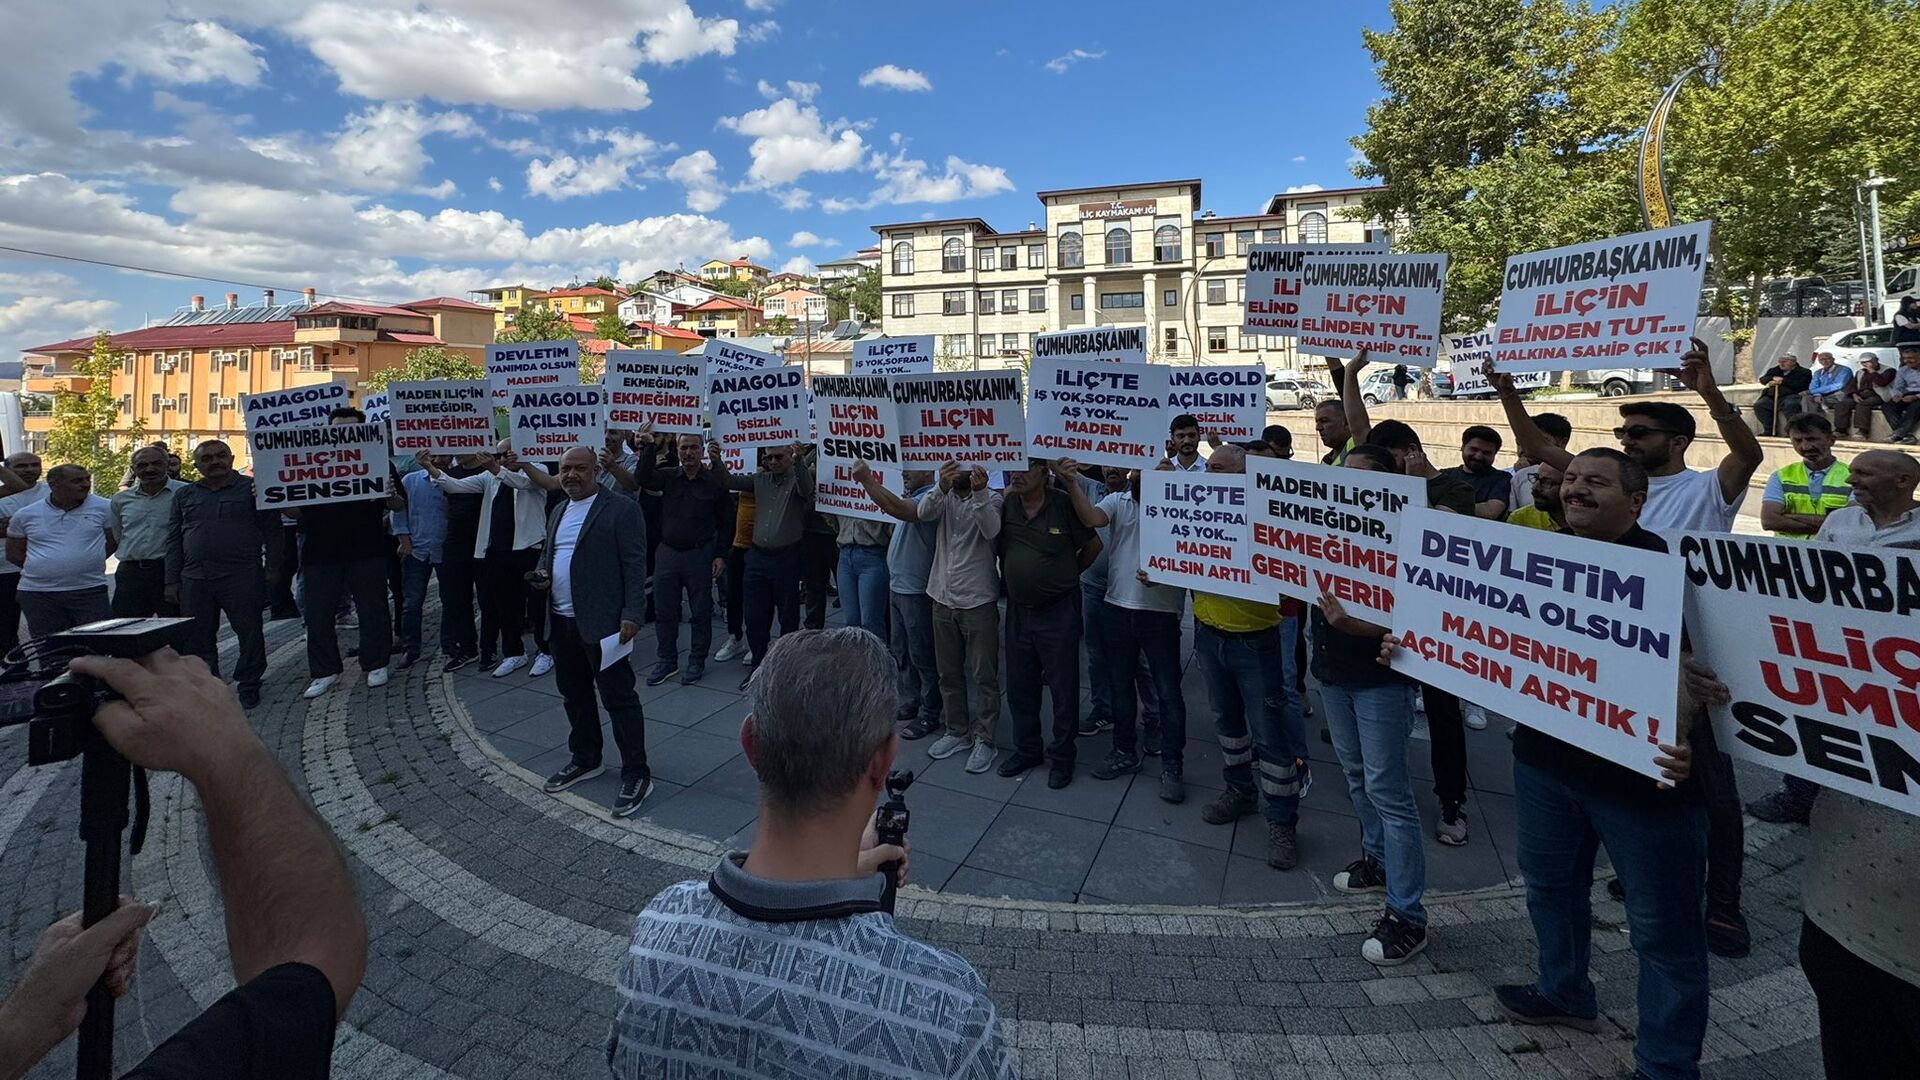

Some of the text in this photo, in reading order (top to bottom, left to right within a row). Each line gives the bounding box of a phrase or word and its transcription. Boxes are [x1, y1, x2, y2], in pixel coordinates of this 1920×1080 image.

[1080, 210, 1094, 219] İLİÇ
[1507, 234, 1702, 291] CUMHURBAŞKANIM,
[1304, 263, 1442, 294] CUMHURBAŞKANIM,
[1326, 294, 1406, 317] İLİÇ'İN
[1535, 282, 1648, 317] İLİÇ'İN
[1302, 317, 1433, 341] ELİNDEN TUT...
[1499, 315, 1686, 345] ELİNDEN TUT...
[869, 343, 917, 357] İLİÇ'TE
[1036, 329, 1143, 357] CUMHURBAŞKANIM,
[1301, 336, 1431, 357] HALKINA SAHİP ÇIK !
[1496, 341, 1682, 361] HALKINA SAHİP ÇIK !
[495, 347, 569, 362] DEVLETİM
[720, 347, 765, 367] İLİÇ'TE
[488, 361, 576, 374] YANIMDA OLSUN
[617, 363, 699, 377] MADEN İLİÇ'İN
[507, 375, 559, 386] MADENİM
[623, 377, 690, 391] EKMEĞİDİR,
[711, 372, 801, 394] ANAGOLD
[813, 377, 892, 402] CUMHURBAŞKANIM,
[1056, 370, 1139, 391] İLİÇ'TE
[248, 386, 344, 411] ANAGOLD
[396, 387, 484, 401] MADEN İLİÇ'İN
[512, 391, 600, 408] ANAGOLD
[612, 391, 700, 408] EKMEĞİMİZİ
[893, 377, 1021, 405] CUMHURBAŞKANIM,
[1035, 390, 1160, 409] İŞ YOK,SOFRADA
[1168, 393, 1257, 409] AÇILSIN !
[405, 401, 477, 414] EKMEĞİDİR,
[717, 396, 788, 417] AÇILSIN
[793, 394, 798, 408] !
[831, 404, 878, 421] İLİÇ'İN
[1061, 407, 1129, 421] AŞ YOK...
[255, 405, 331, 428] AÇILSIN
[396, 415, 490, 431] EKMEĞİMİZİ
[518, 413, 597, 431] AÇILSIN !
[610, 410, 643, 423] GERİ
[650, 412, 693, 426] VERİN
[737, 417, 781, 430] İŞSİZLİK
[920, 408, 994, 430] İLİÇ'İN
[254, 424, 384, 450] CUMHURBAŞKANIM,
[536, 432, 579, 445] İŞSİZLİK
[723, 434, 746, 444] SON
[749, 432, 792, 442] BULSUN
[829, 422, 885, 439] UMUDU
[1065, 421, 1122, 437] MADEN
[395, 435, 493, 448] GERİ VERİN !
[900, 432, 1022, 448] ELİNDEN TUT...
[1033, 435, 1155, 458] AÇILSIN ARTIK !
[284, 449, 361, 469] İLİÇ'İN
[522, 448, 544, 456] SON
[823, 438, 897, 463] SENSİN
[902, 450, 1023, 464] HALKINA SAHİP ÇIK !
[278, 464, 369, 483] UMUDU
[264, 477, 384, 503] SENSİN
[819, 483, 866, 499] ELİNDEN
[1165, 483, 1245, 506] İLİÇ'TE
[1256, 473, 1409, 513] MADEN İLİÇ'İN
[818, 497, 853, 510] HALKINA
[854, 503, 879, 513] SAHİP
[1146, 506, 1247, 526] İŞ YOK,SOFRA
[1268, 499, 1393, 545] EKMEĞİDİR,
[1171, 524, 1237, 542] AŞ YOK...
[1176, 541, 1232, 560] MADEN
[1148, 555, 1204, 577] AÇILSIN
[1421, 529, 1645, 611] DEVLETİM
[1251, 553, 1395, 614] GERİ VERİN
[1403, 562, 1670, 659] YANIMDA OLSUN
[1442, 611, 1597, 684] MADENİM
[1400, 630, 1660, 745] AÇILSIN ARTIK !
